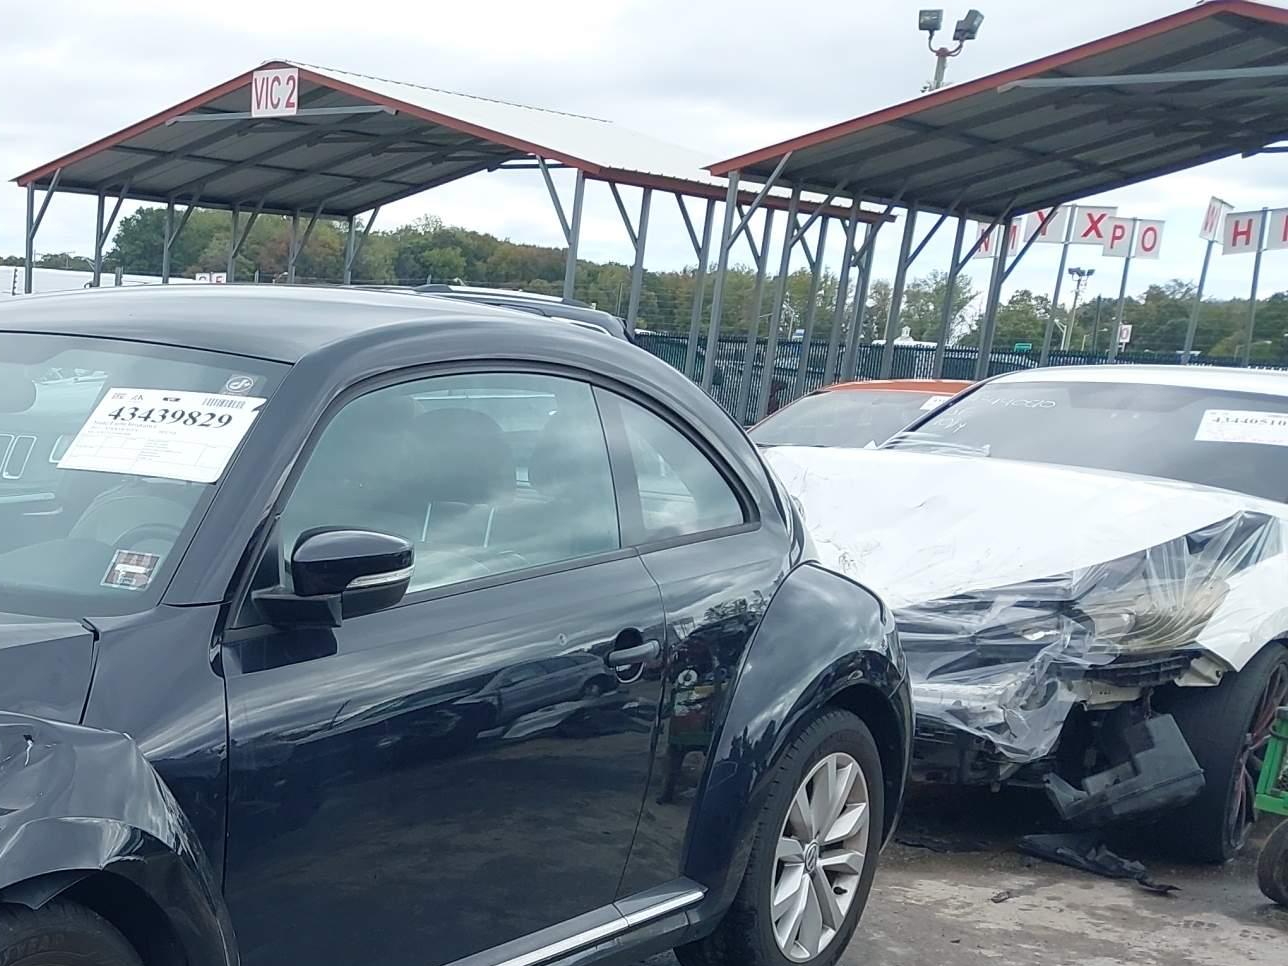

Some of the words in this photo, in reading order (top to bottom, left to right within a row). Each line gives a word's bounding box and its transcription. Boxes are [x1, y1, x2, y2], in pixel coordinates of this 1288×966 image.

[254, 75, 282, 110] VIC
[285, 74, 296, 109] 2
[1081, 212, 1108, 239] X
[1110, 224, 1126, 250] P
[1231, 218, 1253, 248] H
[108, 406, 233, 428] 43439829
